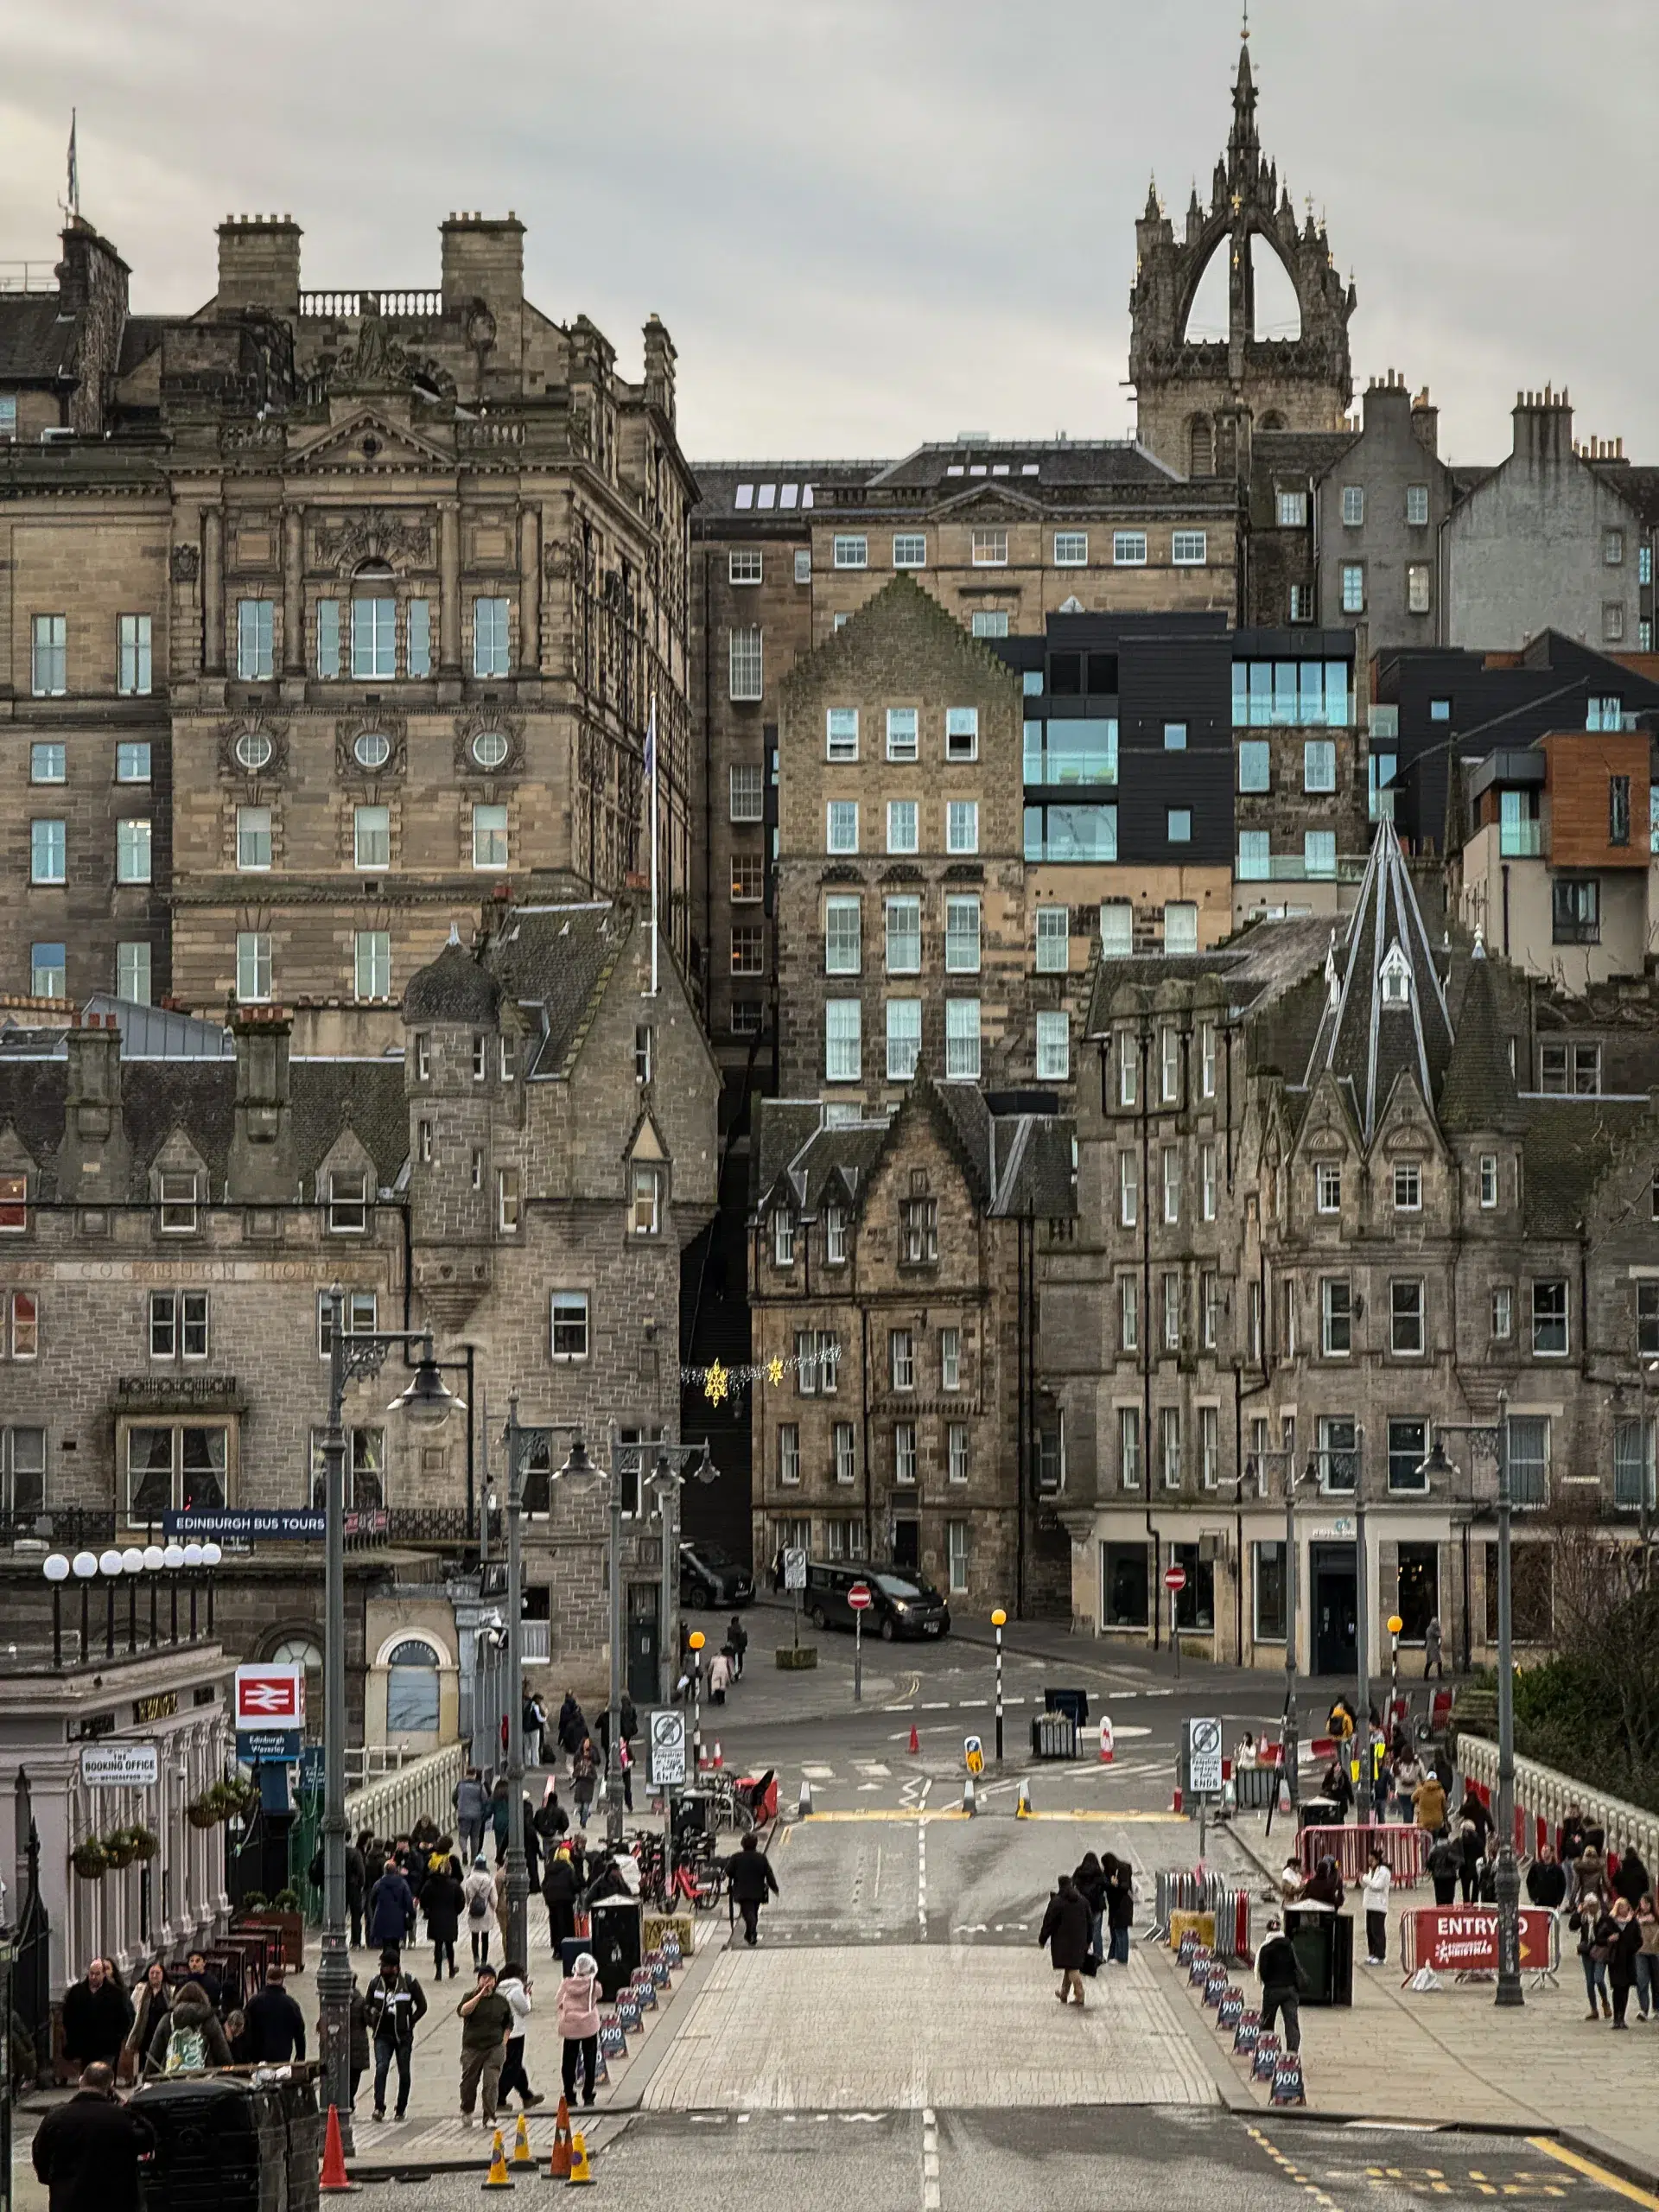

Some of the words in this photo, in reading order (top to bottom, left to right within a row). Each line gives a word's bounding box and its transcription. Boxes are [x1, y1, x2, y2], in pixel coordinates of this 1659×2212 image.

[176, 1516, 251, 1530] EDINBURGH
[254, 1517, 279, 1530] BUS
[283, 1517, 325, 1530] TOURS
[249, 1734, 285, 1746] Edinburgh
[251, 1745, 285, 1755] Waverley
[85, 1760, 123, 1772] BOOKING
[125, 1759, 155, 1770] OFFICE
[1437, 1916, 1498, 1936] ENTRY
[1192, 1960, 1211, 1973] 900
[1209, 1980, 1228, 1993] 900
[1223, 2001, 1243, 2015] 900
[601, 2028, 622, 2043] 900
[1239, 2024, 1260, 2039] 900
[1276, 2072, 1300, 2087] 900
